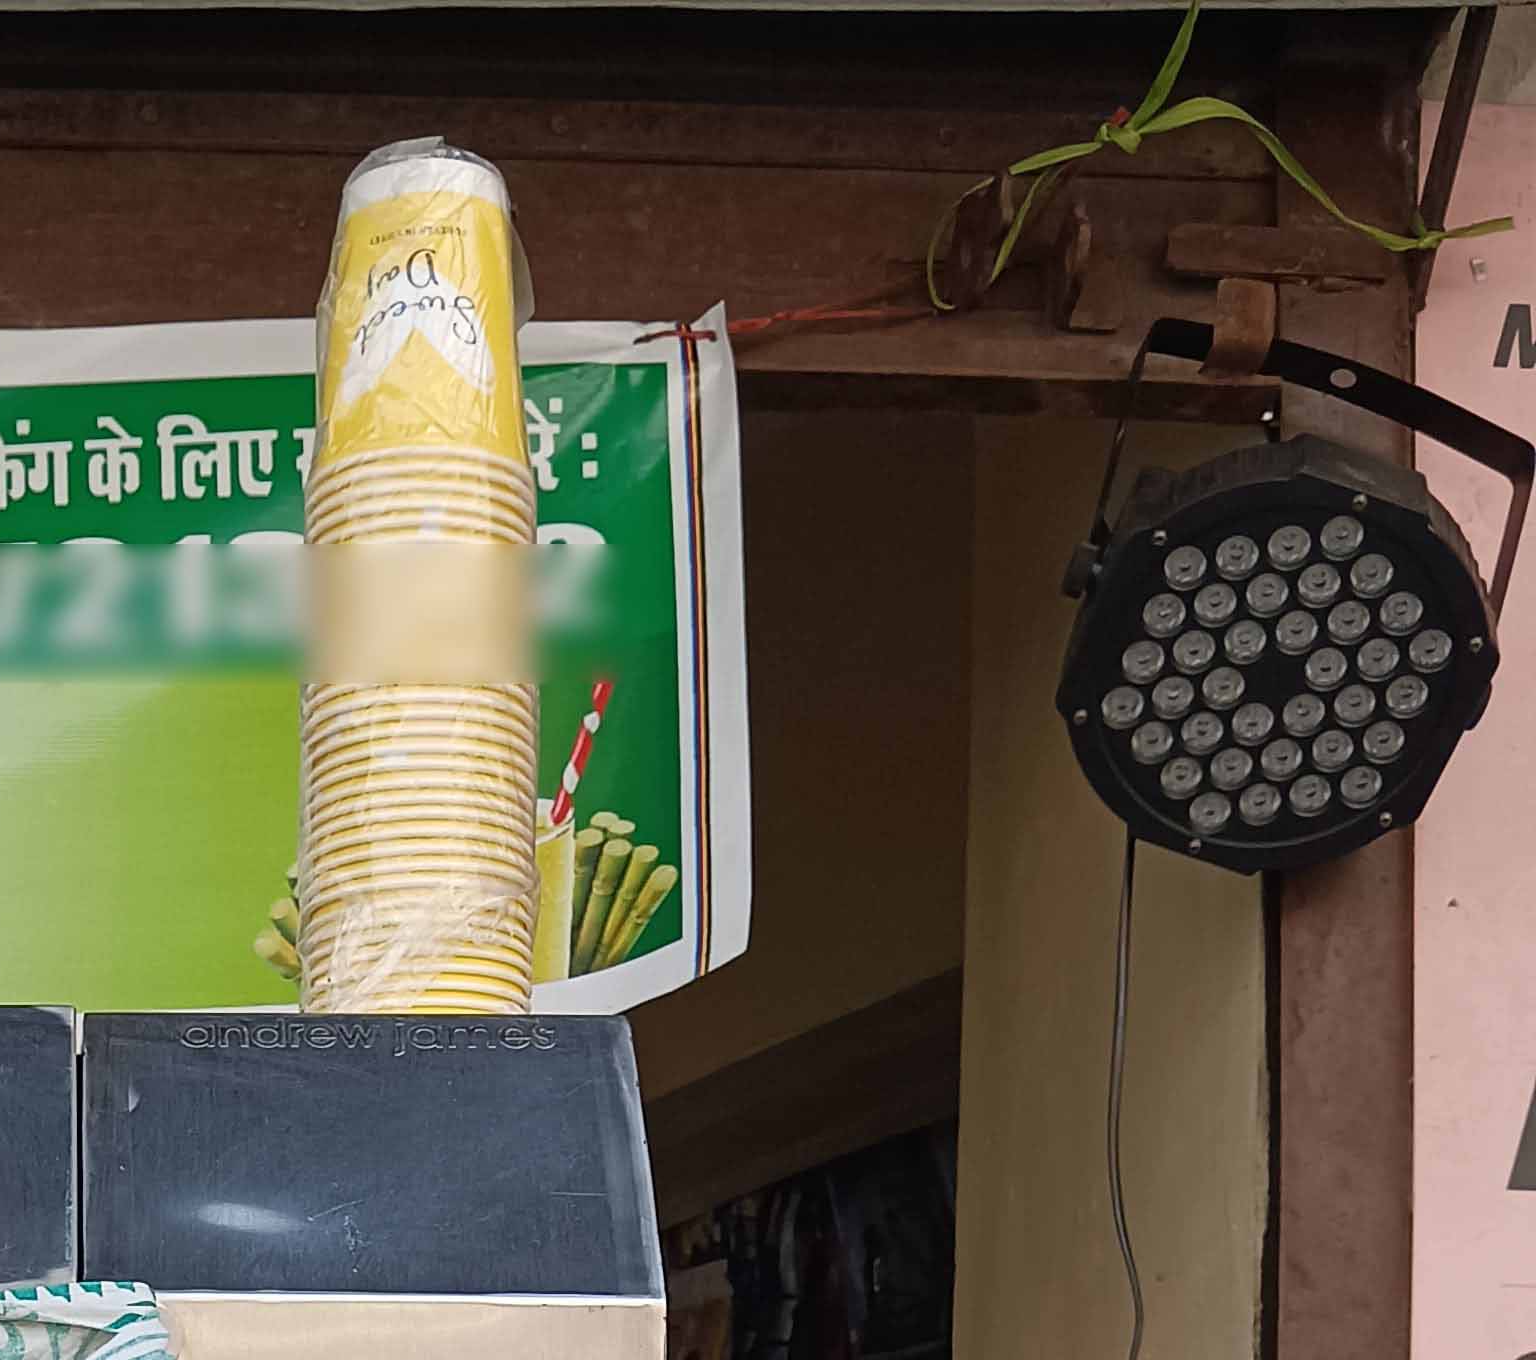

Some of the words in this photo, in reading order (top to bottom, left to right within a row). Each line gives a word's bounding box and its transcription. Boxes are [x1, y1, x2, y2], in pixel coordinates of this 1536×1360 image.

[85, 416, 143, 504] के
[156, 413, 279, 500] लिए
[178, 1018, 376, 1050] andrew
[393, 1018, 558, 1056] james
